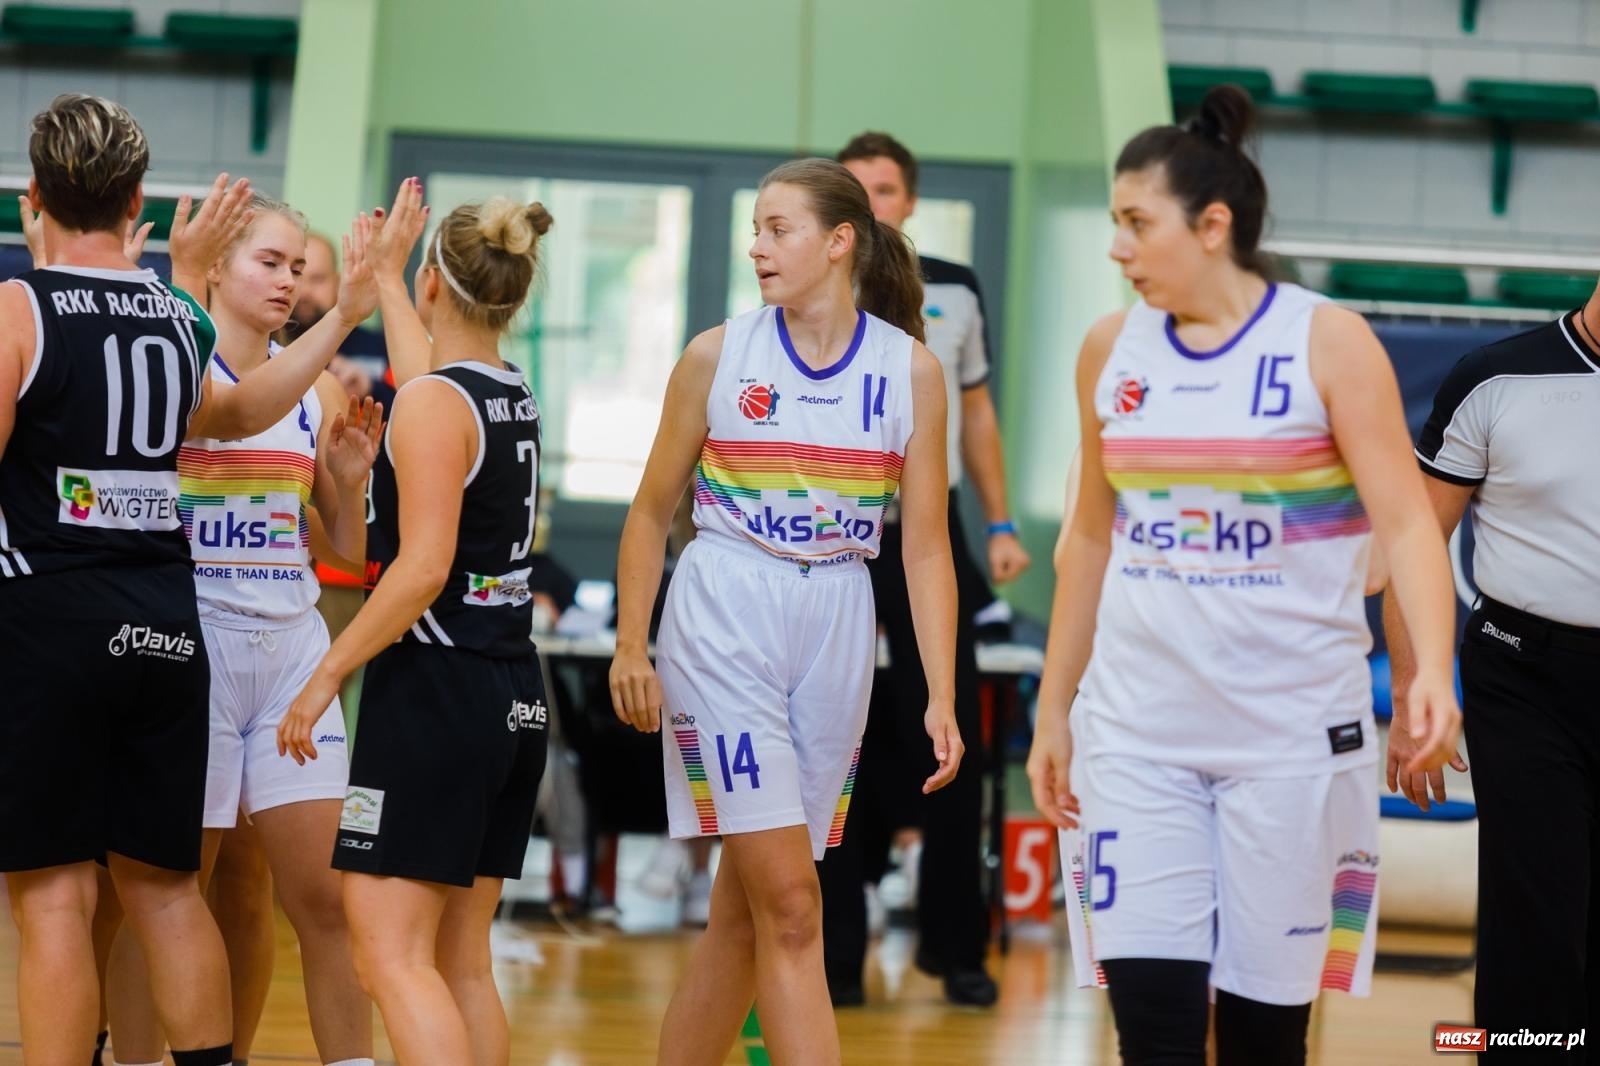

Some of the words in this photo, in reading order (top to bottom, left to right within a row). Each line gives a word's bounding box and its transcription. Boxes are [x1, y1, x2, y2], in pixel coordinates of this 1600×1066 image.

[51, 289, 99, 315] RKK
[103, 333, 181, 457] 10
[862, 373, 887, 432] 14
[1250, 355, 1294, 416] 15
[510, 440, 536, 562] 3
[193, 567, 232, 579] MORE
[236, 568, 268, 580] THAN
[272, 570, 305, 582] BASK
[132, 626, 195, 656] Clavis
[1481, 621, 1521, 649] SPALDING
[716, 732, 760, 792] 14
[1003, 828, 1048, 911] 5
